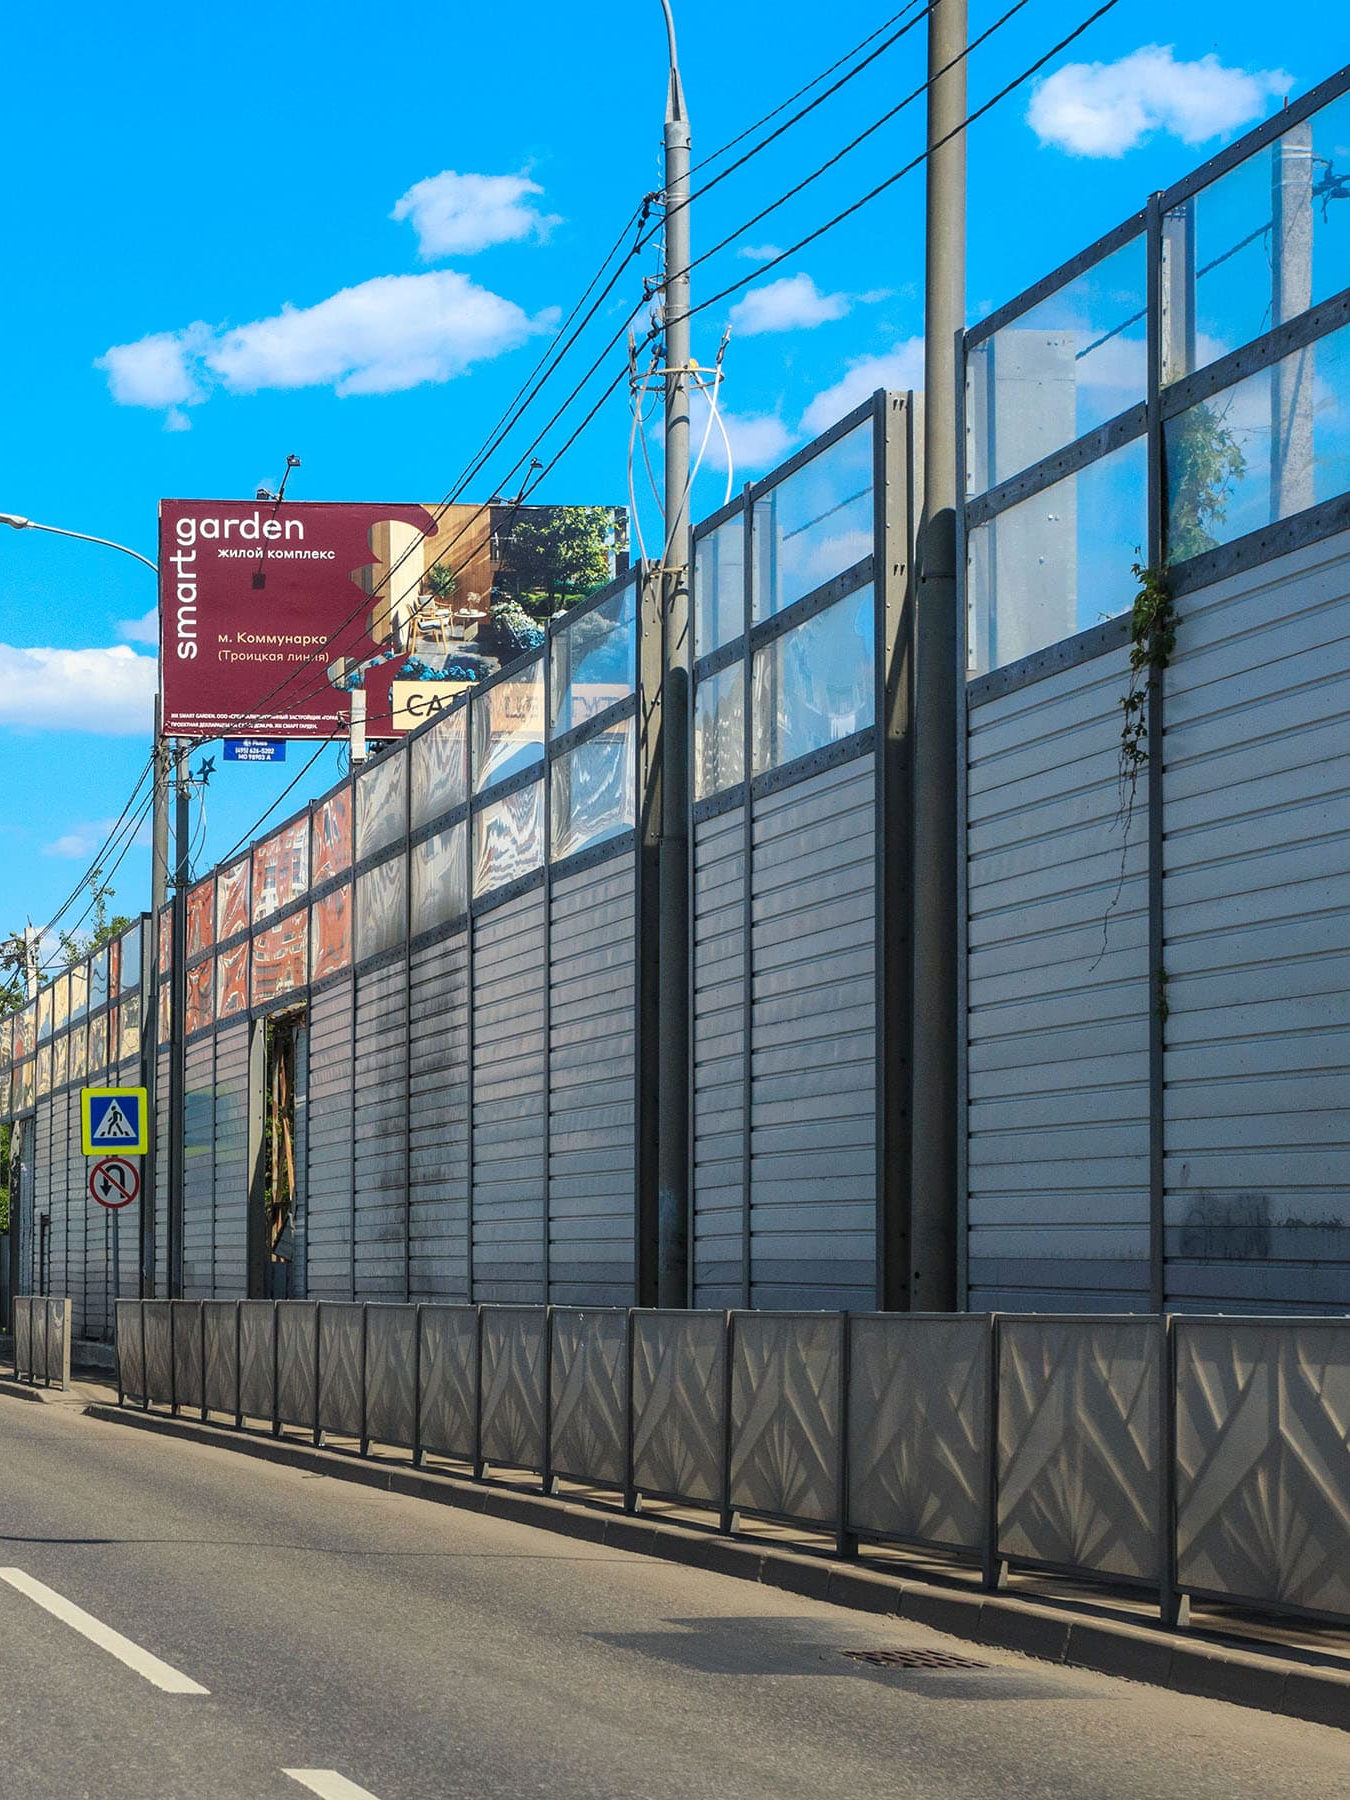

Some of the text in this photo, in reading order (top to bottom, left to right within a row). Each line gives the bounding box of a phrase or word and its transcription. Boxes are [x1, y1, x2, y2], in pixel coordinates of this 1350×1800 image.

[175, 511, 304, 546] garden
[217, 547, 336, 560] жилой комплекс
[169, 549, 198, 660] smart
[218, 632, 328, 647] м. Коммунарка
[218, 650, 330, 663] (Троицкая линия)
